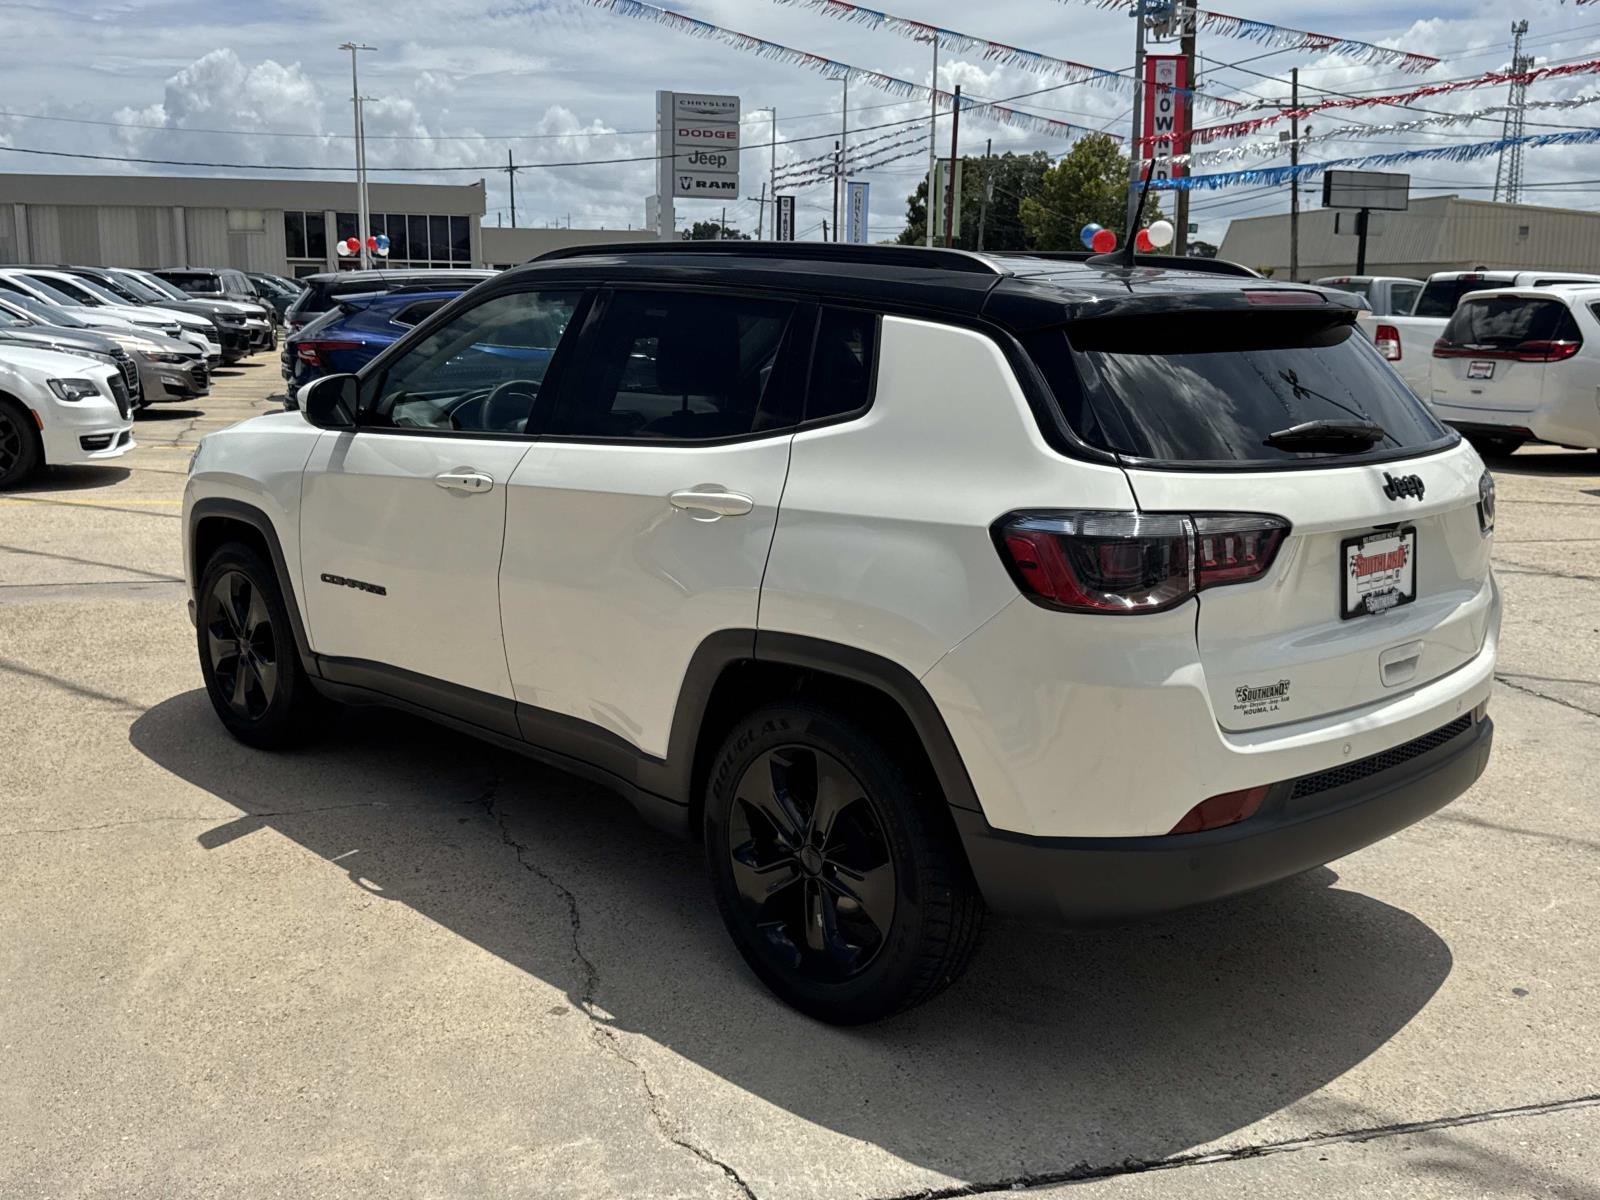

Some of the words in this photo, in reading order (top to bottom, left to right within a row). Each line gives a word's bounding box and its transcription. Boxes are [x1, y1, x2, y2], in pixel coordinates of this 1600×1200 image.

[679, 100, 735, 108] CHRYSLER
[678, 128, 737, 139] DODGE
[688, 150, 728, 169] Jeep
[695, 180, 736, 190] RAM
[782, 212, 790, 241] TRUC
[1382, 471, 1425, 502] Jeep
[1242, 682, 1285, 701] SOUTHLAND
